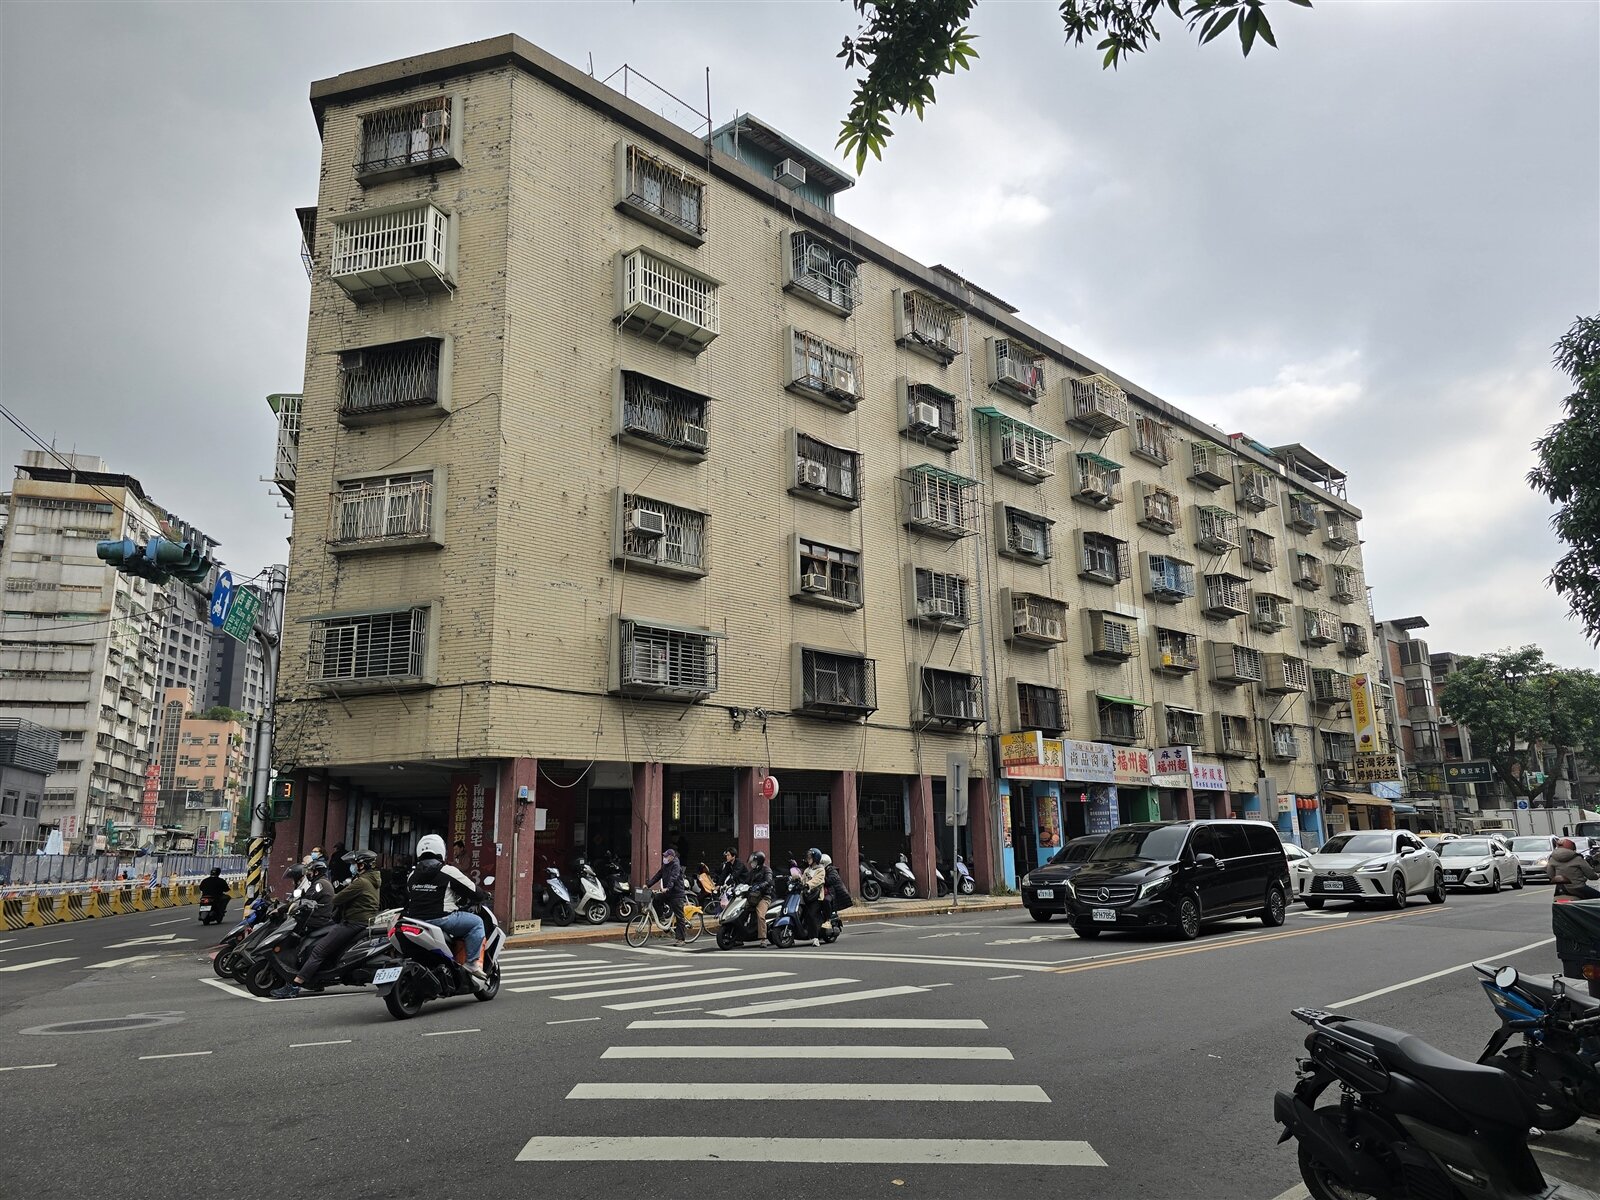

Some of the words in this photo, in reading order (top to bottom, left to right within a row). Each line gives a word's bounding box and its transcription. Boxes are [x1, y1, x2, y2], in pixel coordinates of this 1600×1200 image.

[1355, 691, 1366, 724] 公益彩券
[1161, 749, 1182, 759] 麻吉
[1117, 750, 1149, 774] 福州麵
[1157, 759, 1188, 773] 福州麵
[1355, 756, 1397, 769] 台灣彩券
[1357, 768, 1400, 780] 婷婷投注站
[284, 783, 292, 797] 3
[470, 783, 485, 847] 南機場整宅
[471, 849, 481, 868] 單元
